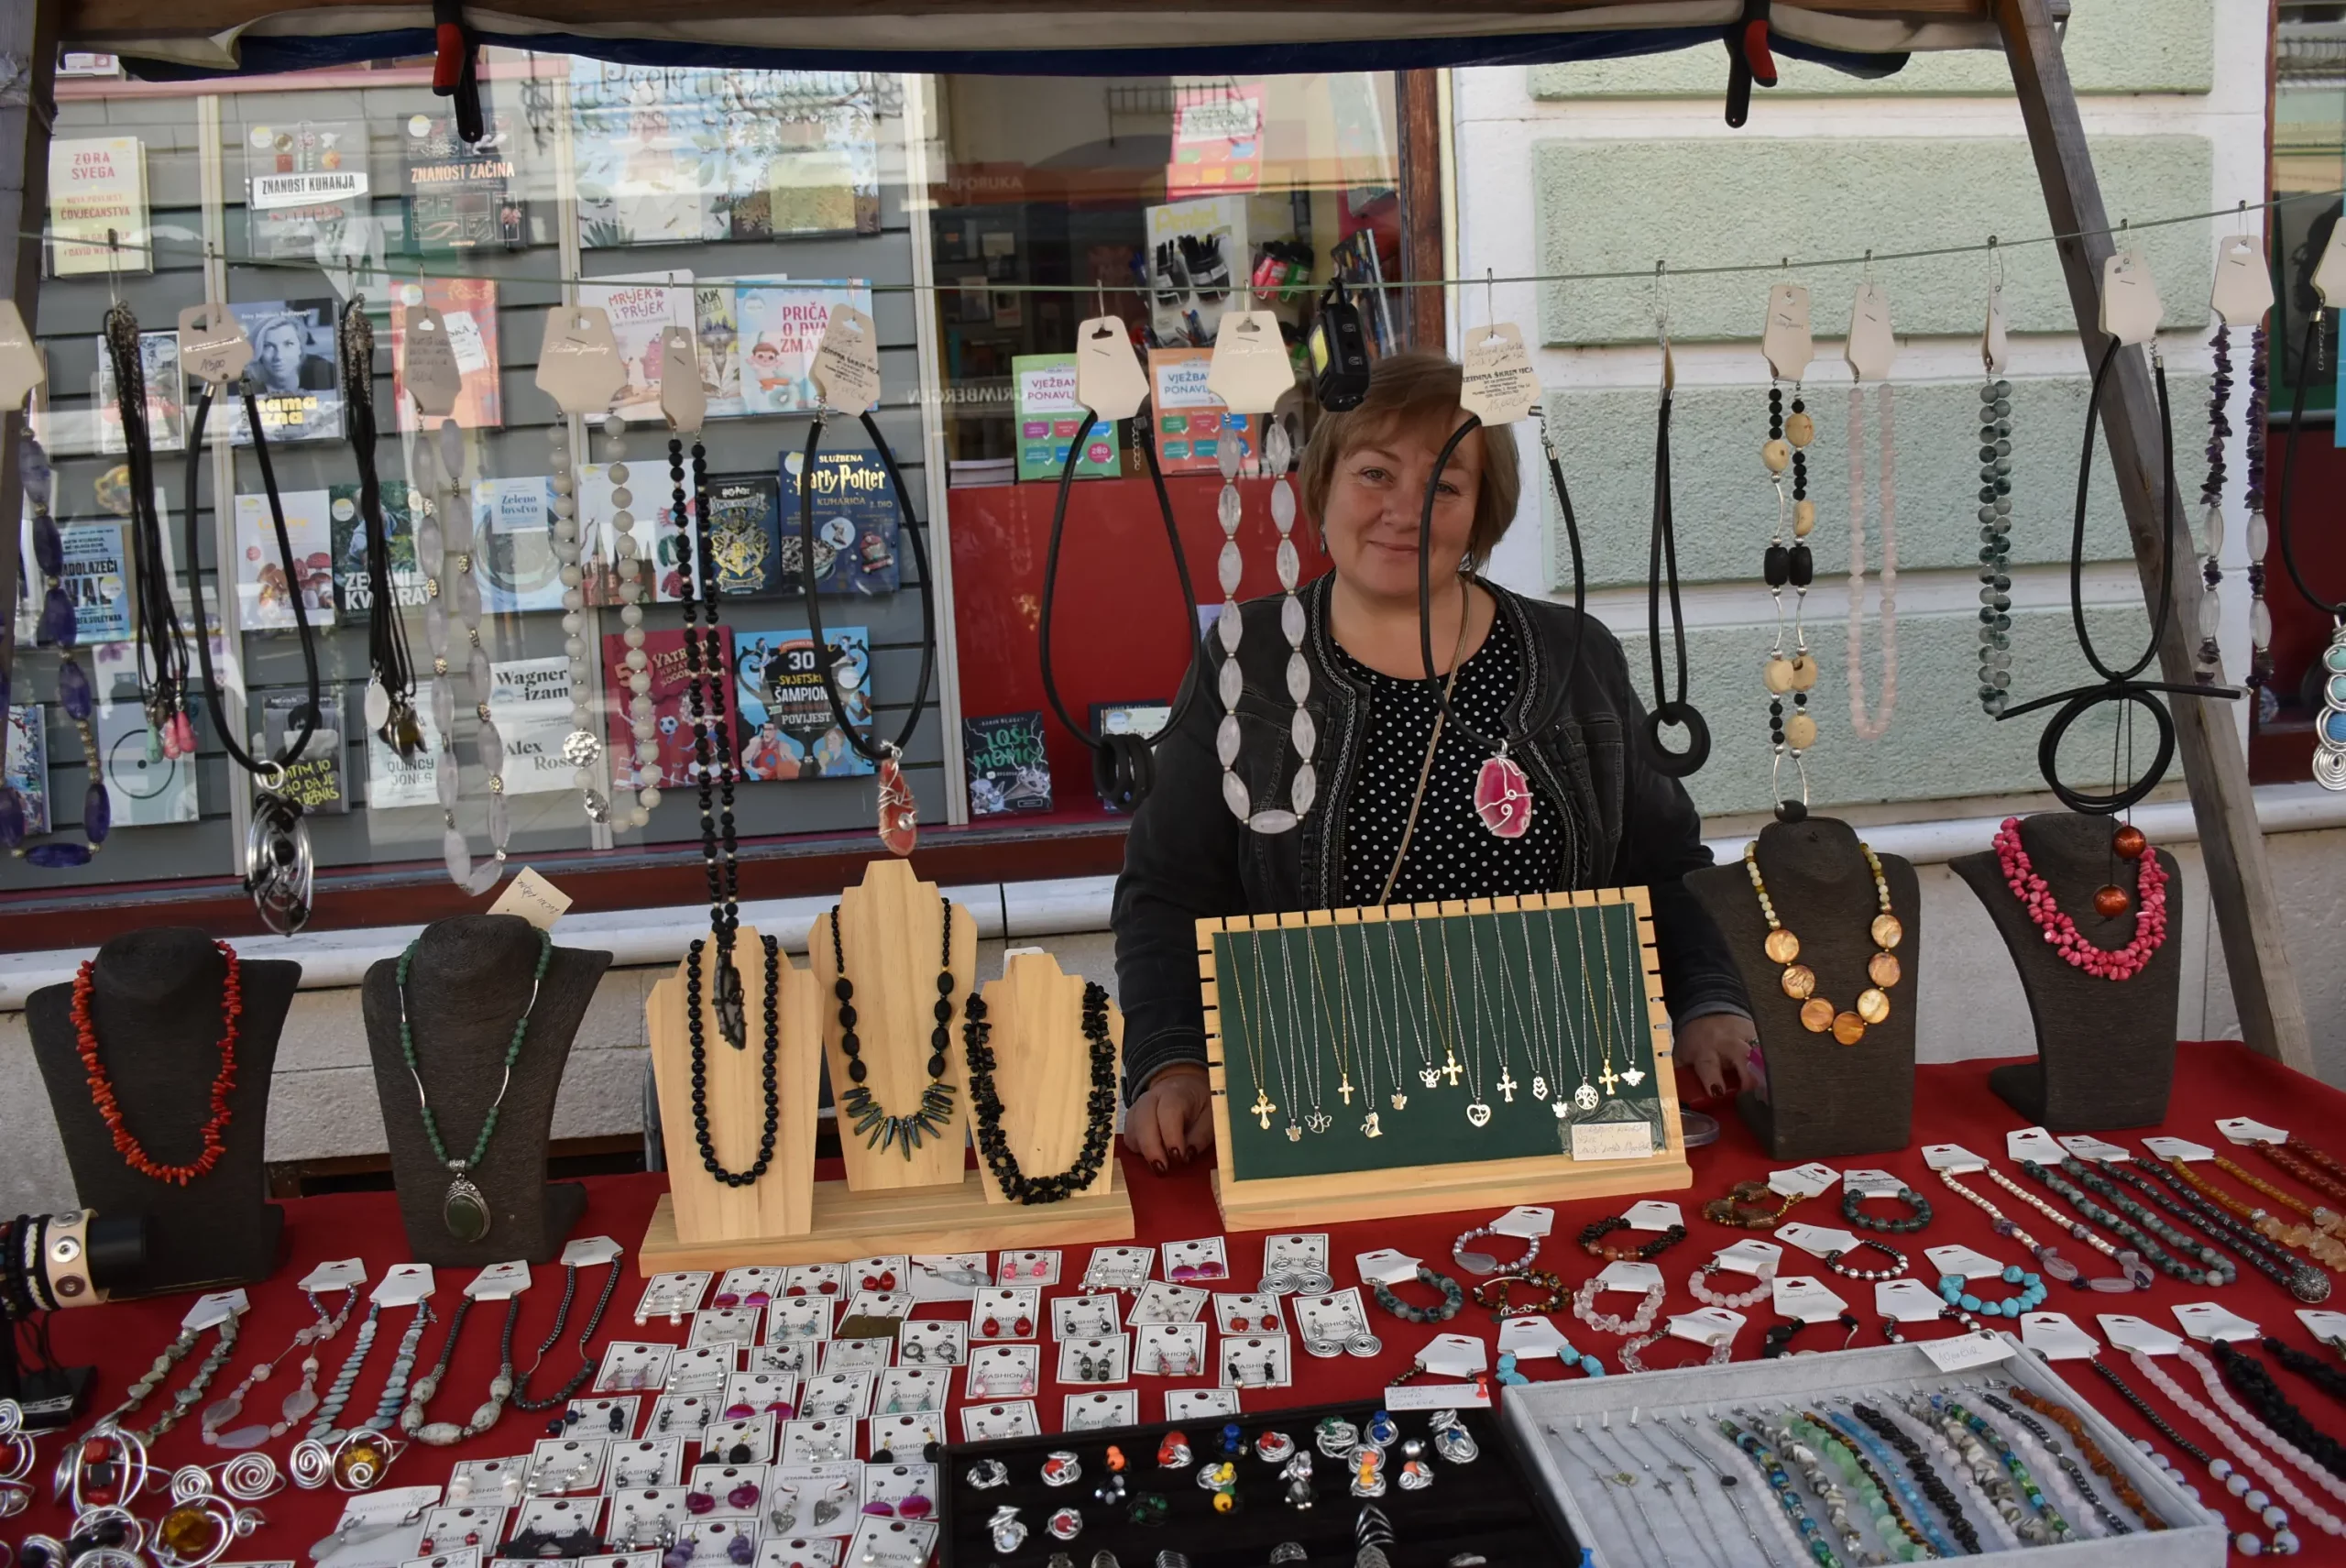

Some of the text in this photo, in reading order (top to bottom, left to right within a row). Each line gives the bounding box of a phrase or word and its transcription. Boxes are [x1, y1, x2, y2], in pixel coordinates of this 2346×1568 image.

[73, 151, 111, 165] ZORA
[71, 166, 115, 181] SVEGA
[411, 160, 515, 183] ZNANOST ZAČINA
[262, 174, 356, 195] ZNANOST KUHANJA
[60, 206, 131, 221] ČOVJEČANSTVA
[783, 301, 828, 321] PRIČA
[783, 322, 793, 337] O
[818, 454, 863, 464] SLUŽBENA
[501, 495, 537, 505] Zeleno
[817, 497, 866, 507] KUHARICA
[787, 651, 816, 671] 30
[496, 669, 568, 686] Wagner
[782, 712, 832, 725] POVIJEST
[985, 724, 1029, 750] LOŠI
[504, 740, 543, 756] Alex
[388, 758, 434, 772] QUINCY
[305, 778, 321, 792] DA
[322, 774, 335, 786] JE
[391, 772, 433, 786] JONES
